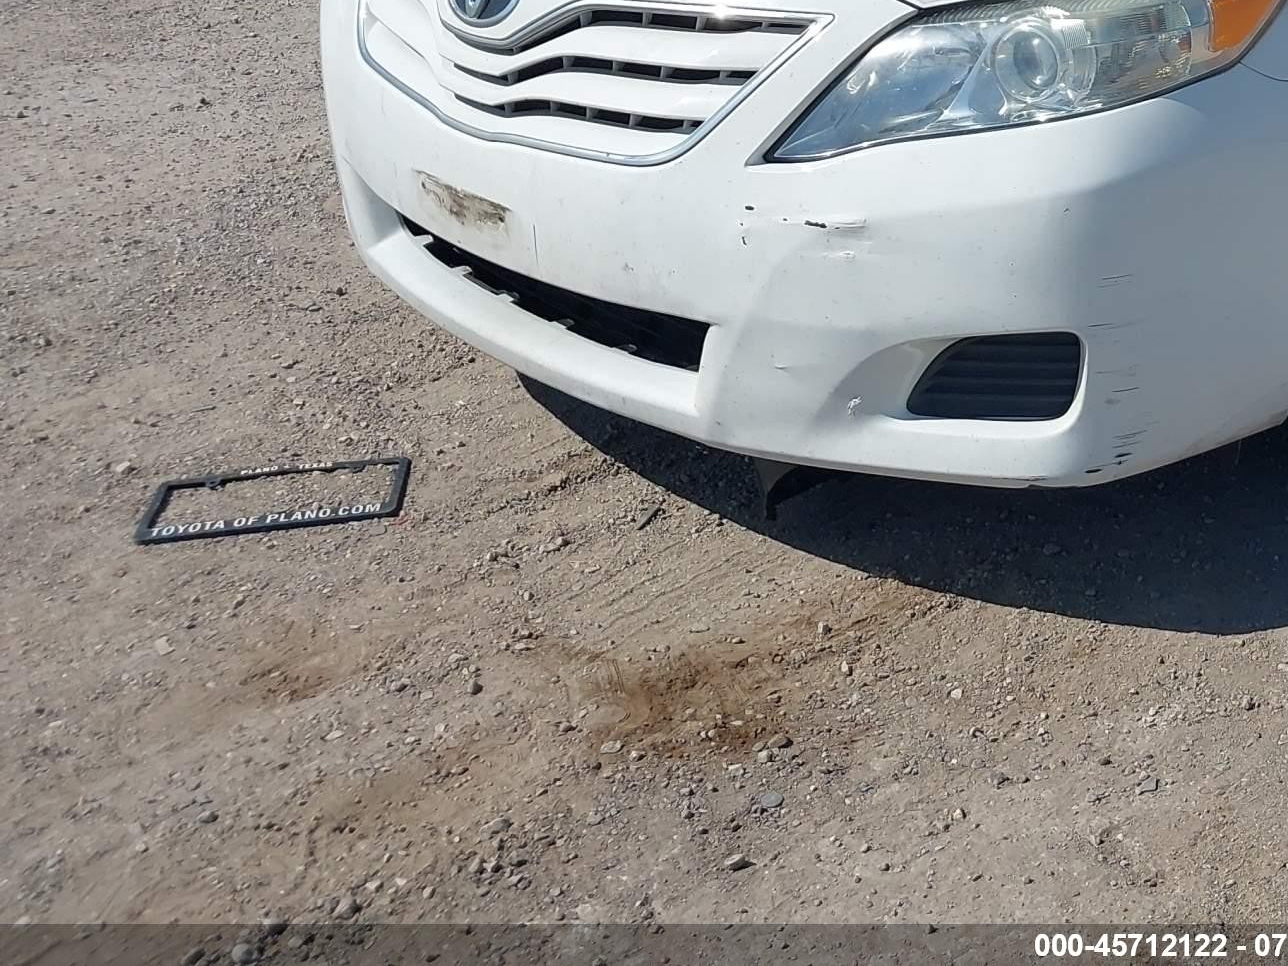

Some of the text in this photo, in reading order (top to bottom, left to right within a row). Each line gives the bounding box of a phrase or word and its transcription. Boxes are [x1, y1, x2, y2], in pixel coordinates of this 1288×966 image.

[240, 461, 334, 475] PLANO TEXAS
[151, 503, 382, 537] TOYOTA OF PLANO.COM
